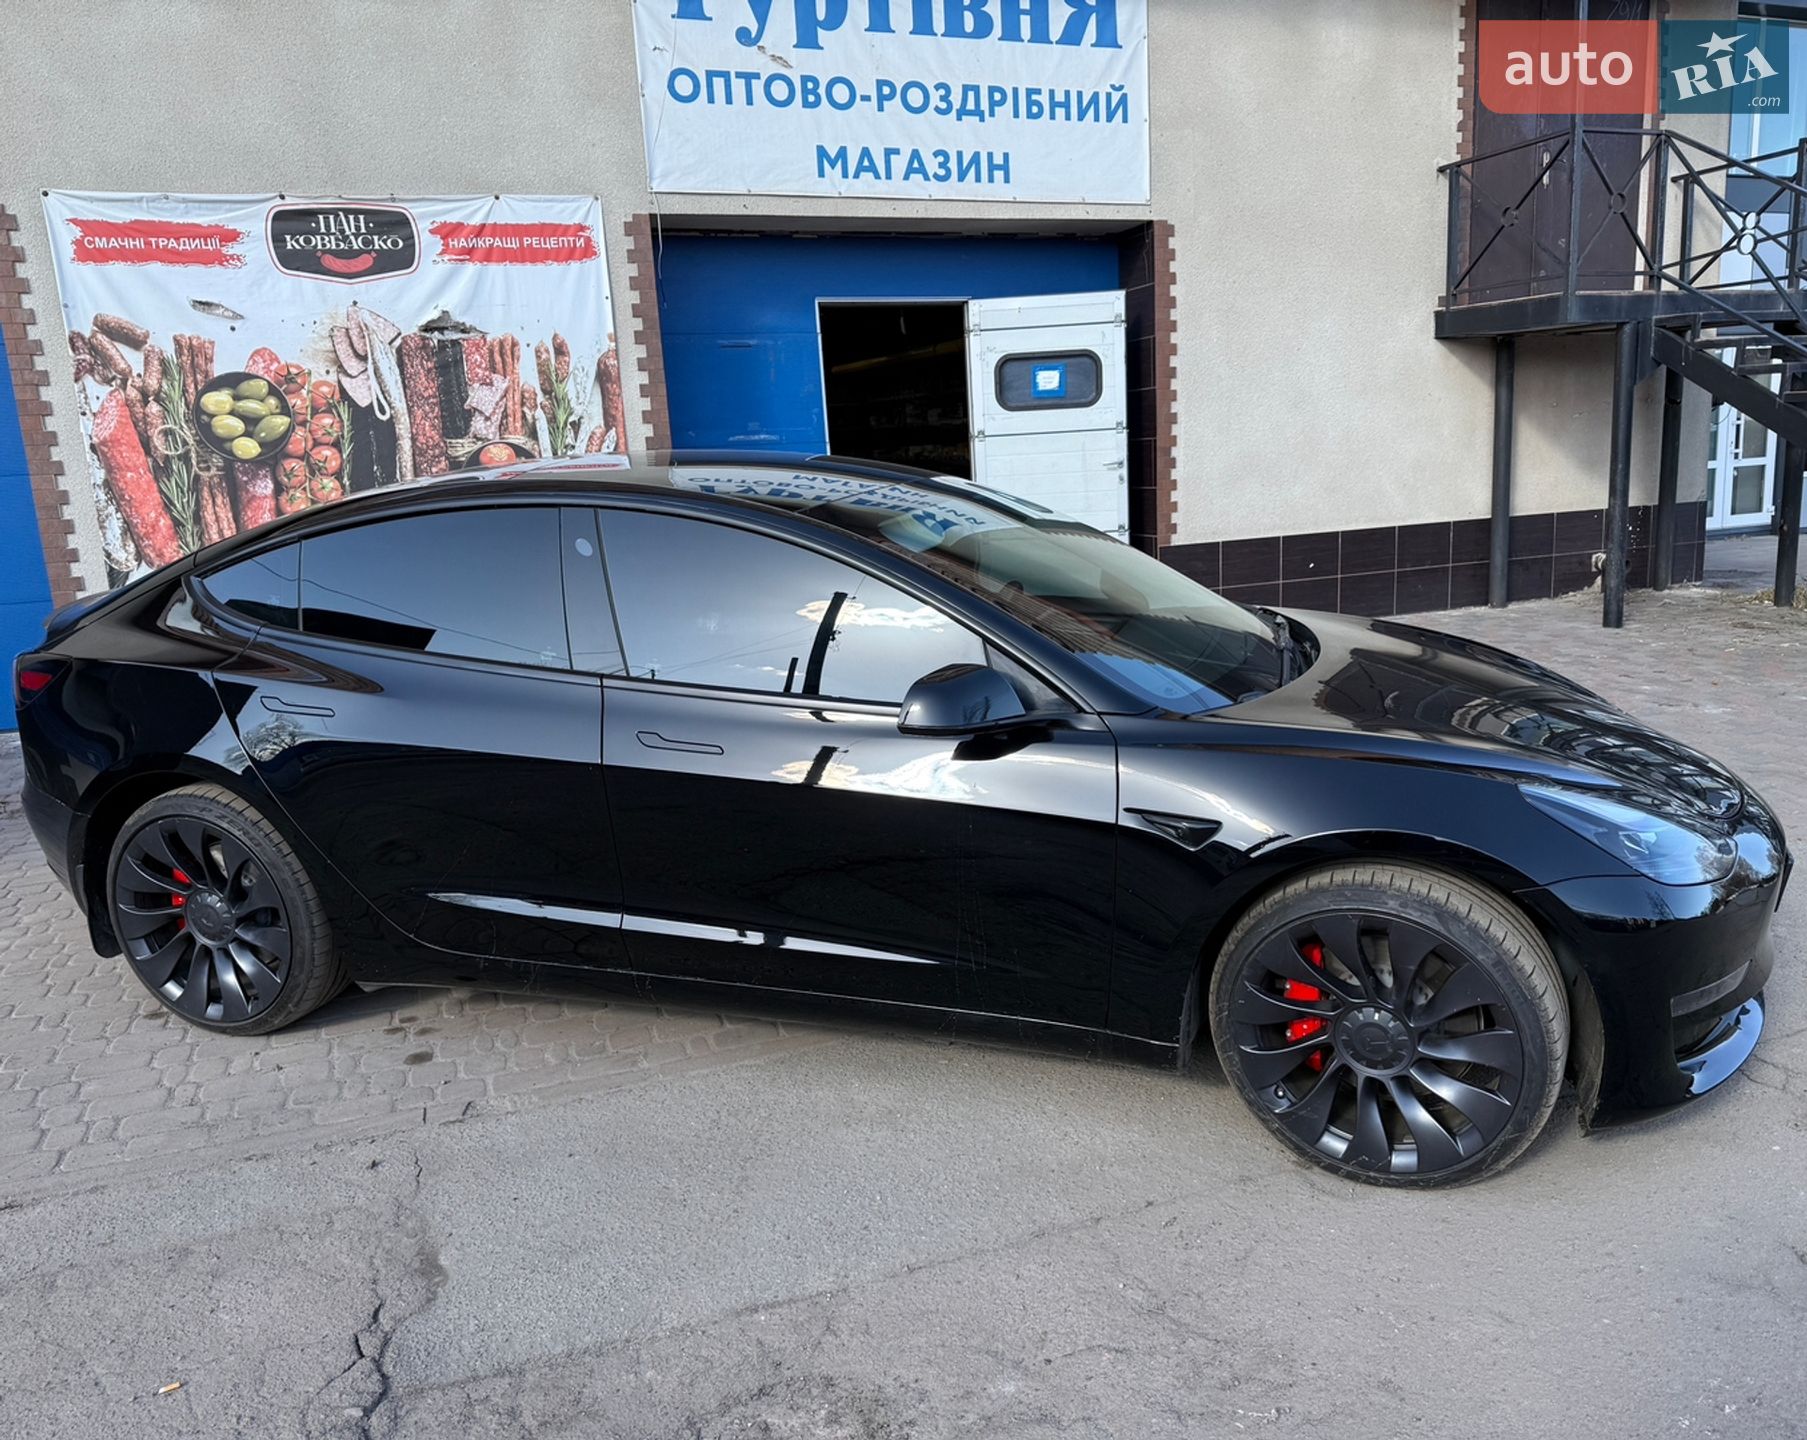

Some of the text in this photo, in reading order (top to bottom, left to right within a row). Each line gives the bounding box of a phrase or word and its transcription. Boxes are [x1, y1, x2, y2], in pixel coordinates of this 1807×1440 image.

[667, 67, 1129, 123] ОПТОВО-РОЗДРІБНИЙ
[816, 145, 1011, 184] МАГАЗИН
[317, 212, 367, 236] ПАН
[84, 235, 221, 251] СМАЧНІ ТРАДИЦІЇ
[448, 235, 585, 249] НАЙКРАЩІ РЕЦЕПТИ
